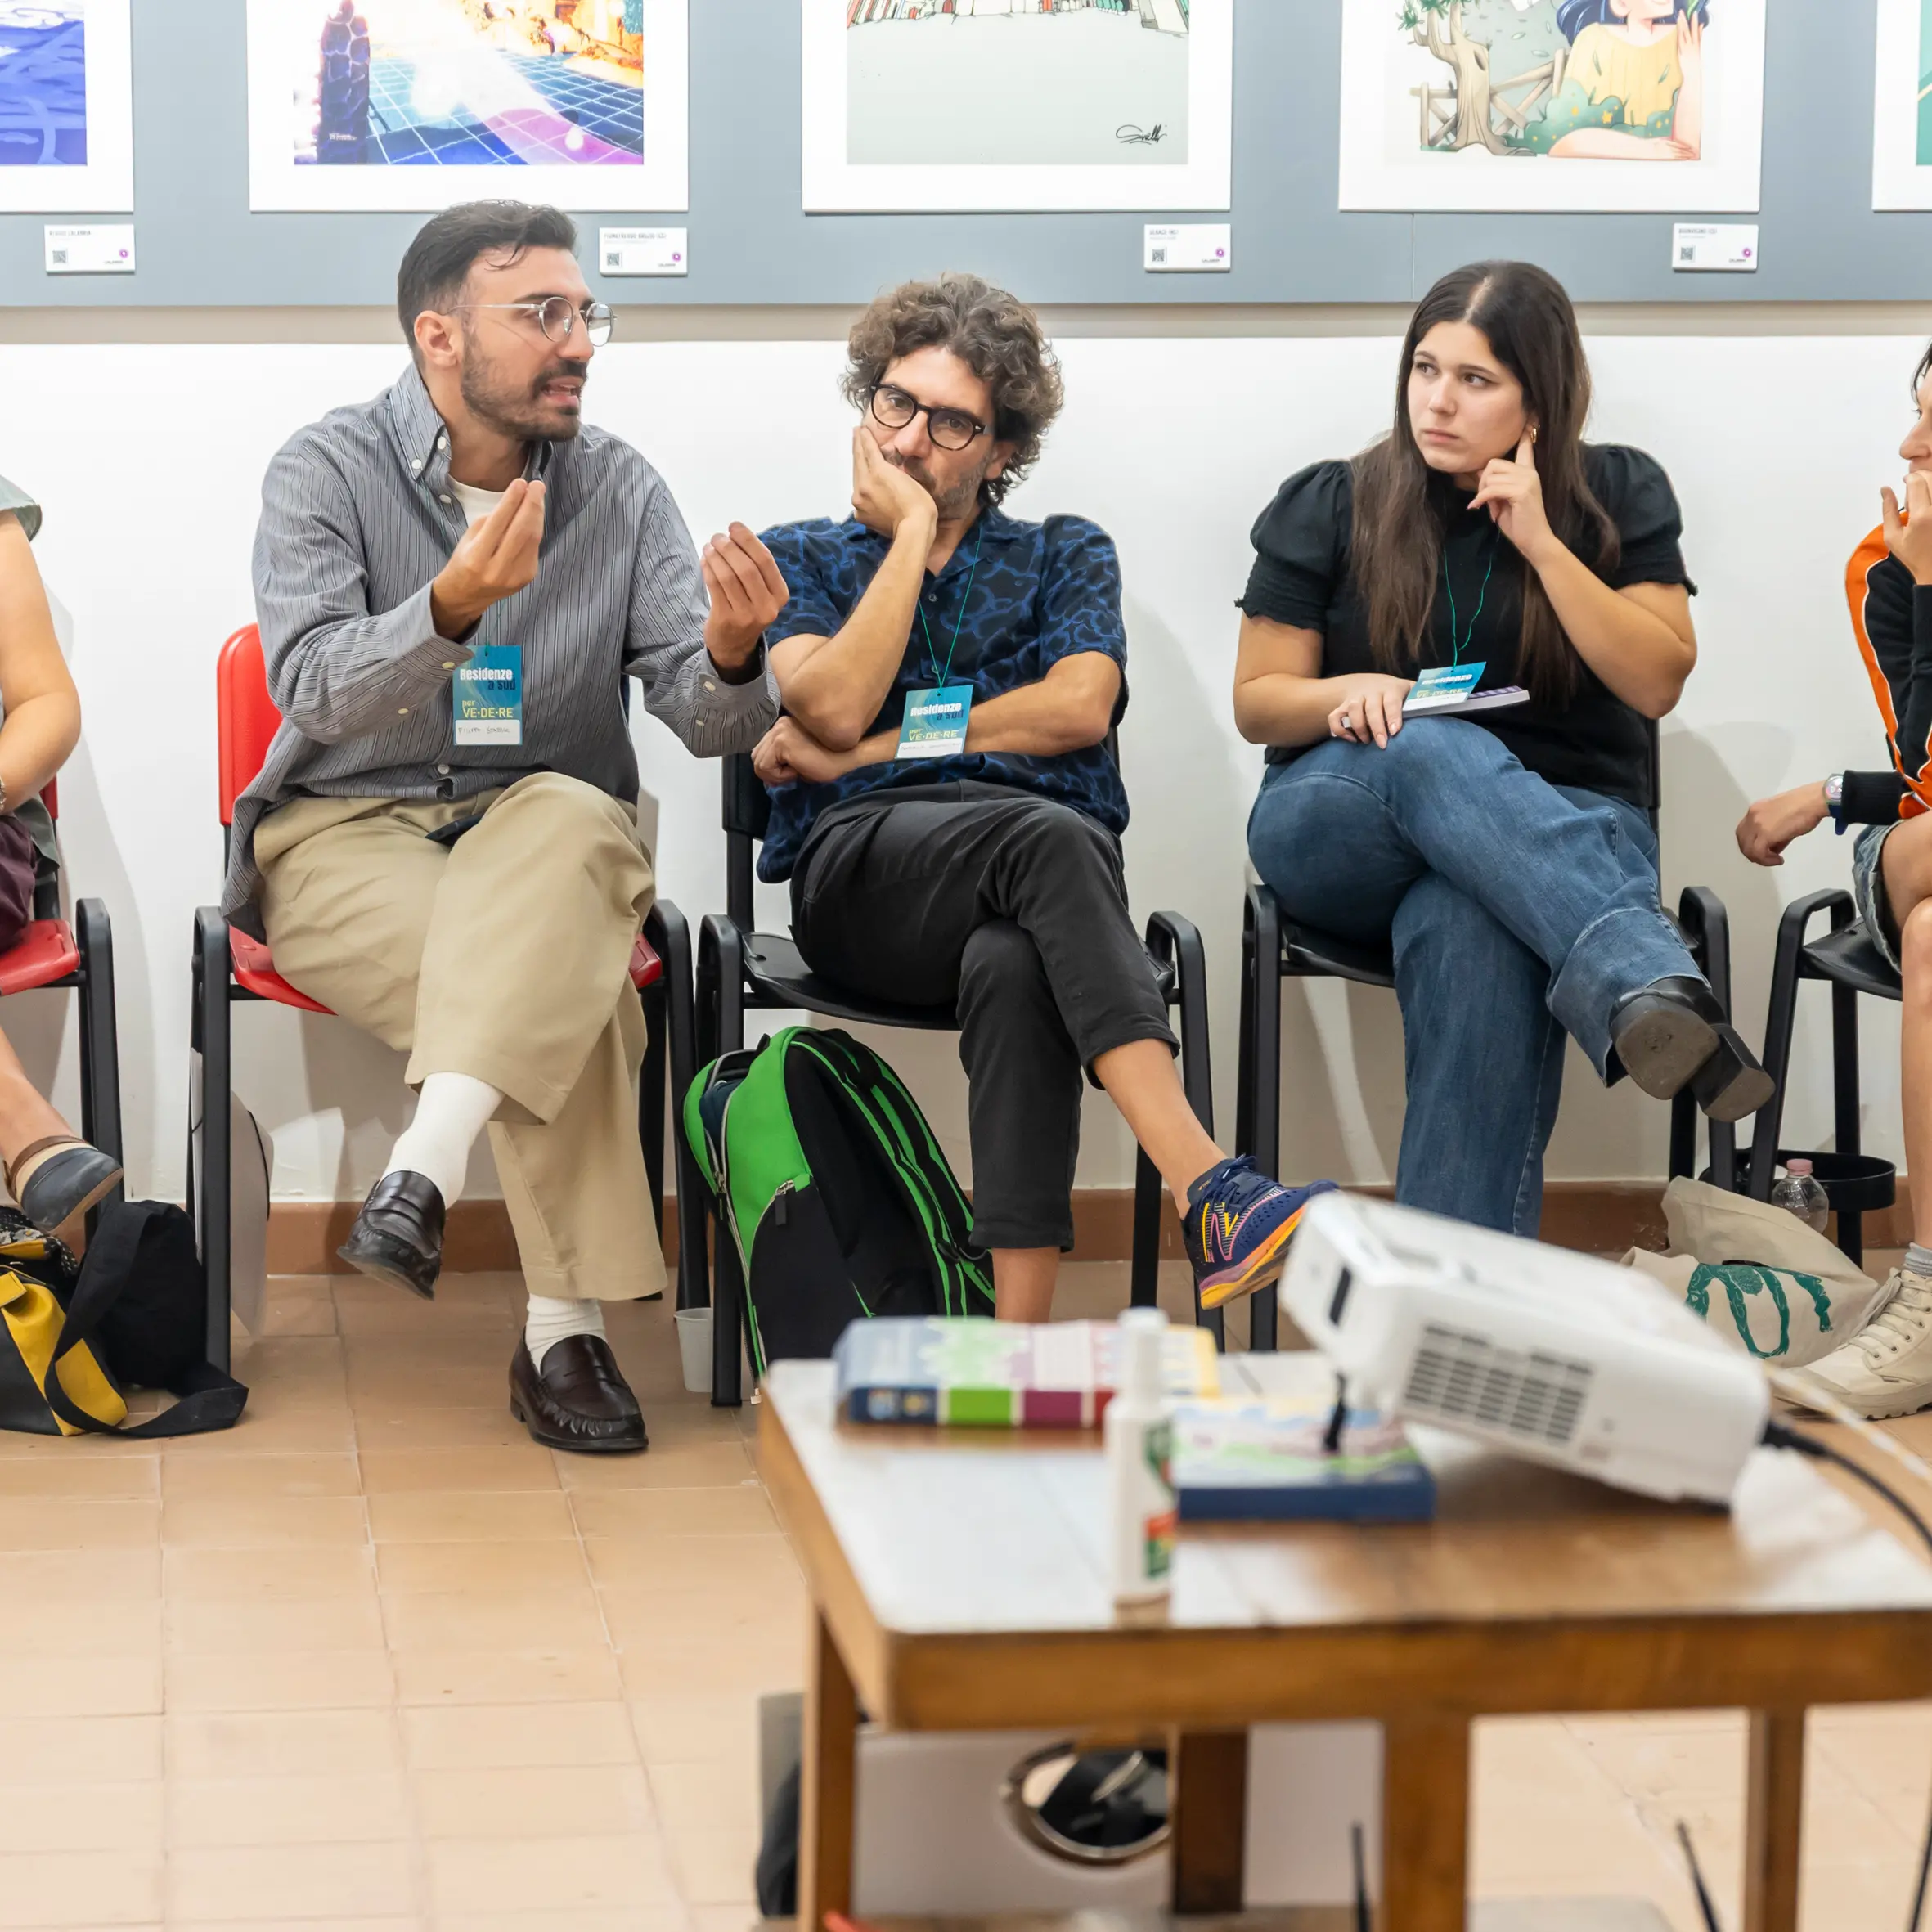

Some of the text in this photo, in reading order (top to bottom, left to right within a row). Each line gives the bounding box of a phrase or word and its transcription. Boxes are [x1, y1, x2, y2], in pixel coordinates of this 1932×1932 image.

[460, 667, 513, 681] Residenze
[488, 678, 516, 690] a sud
[910, 703, 962, 717] Residenze
[945, 709, 964, 720] sud
